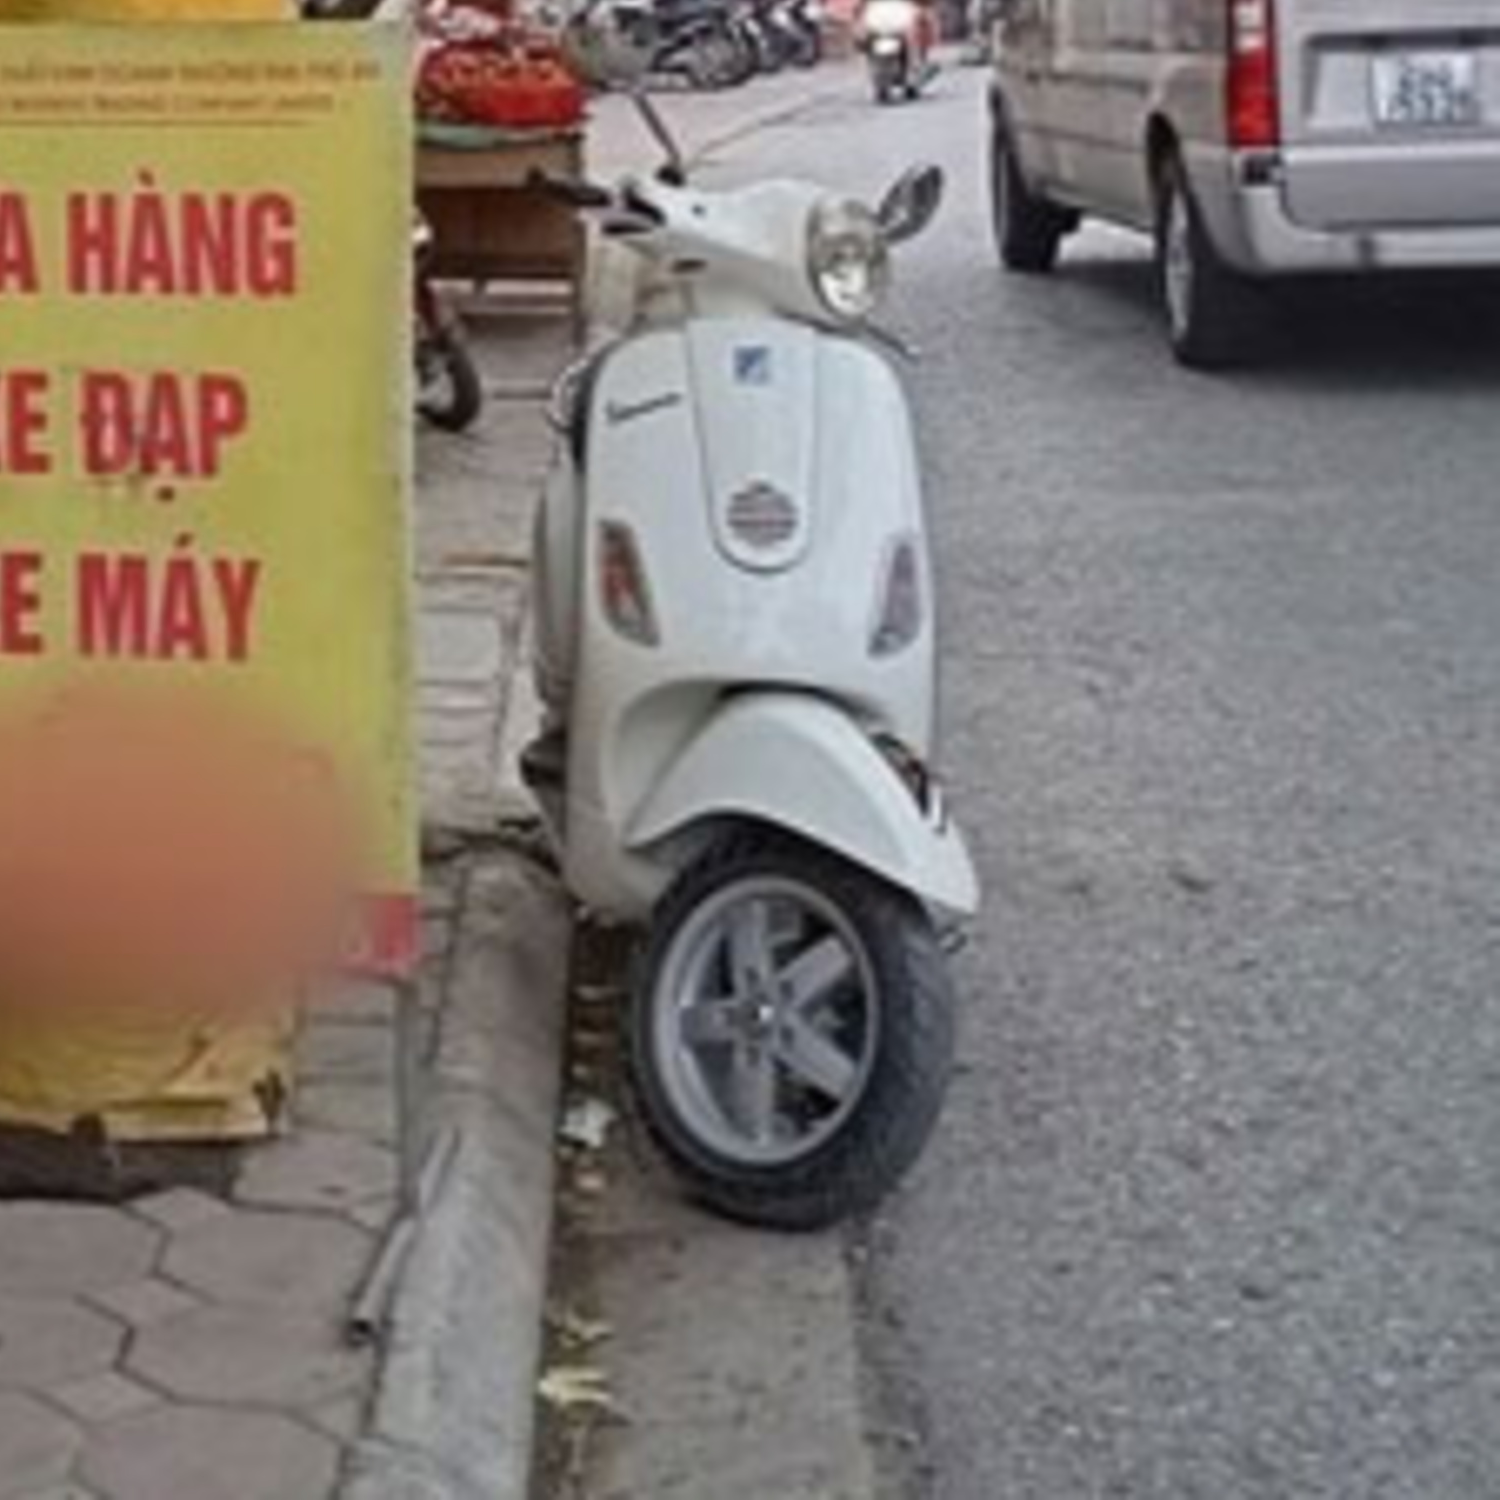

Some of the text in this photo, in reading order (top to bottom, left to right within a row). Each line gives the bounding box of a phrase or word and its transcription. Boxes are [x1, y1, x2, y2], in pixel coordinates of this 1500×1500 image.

[66, 168, 297, 298] HÀNG
[80, 369, 248, 501] ĐẠP
[76, 532, 261, 662] MÁY
